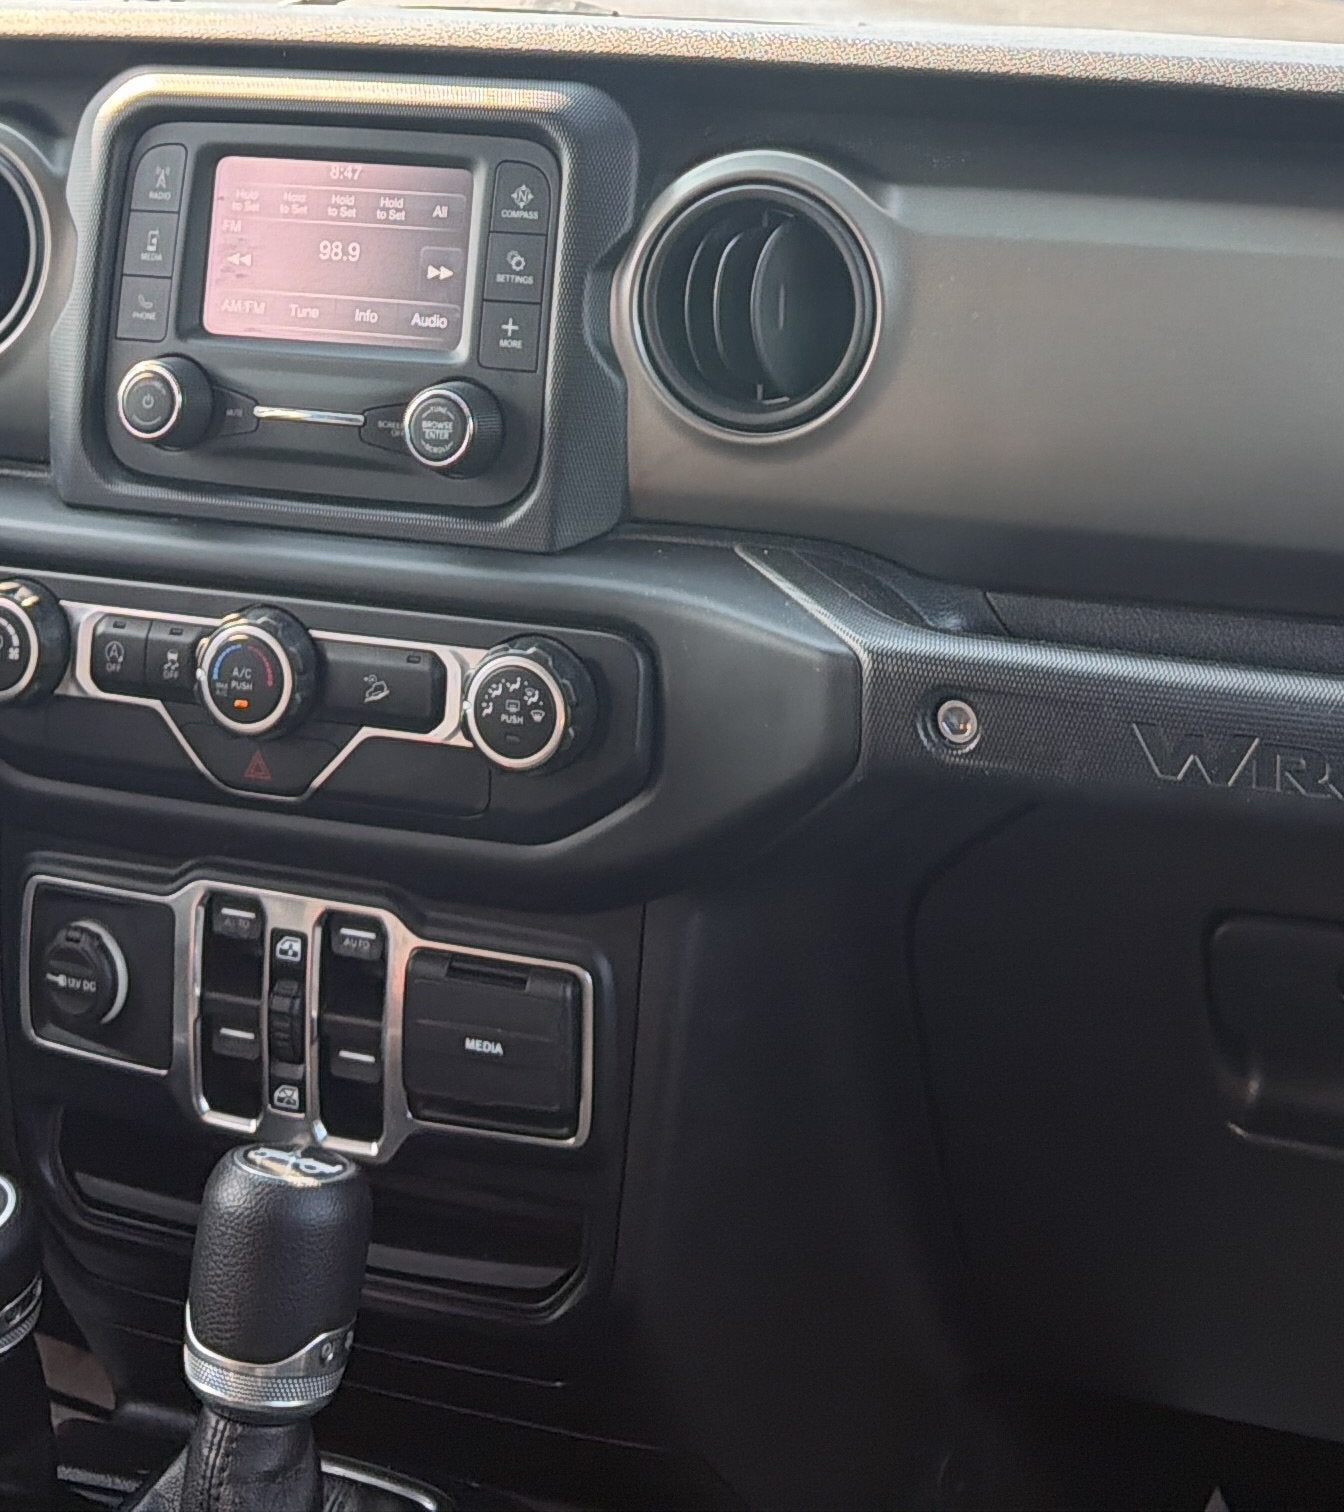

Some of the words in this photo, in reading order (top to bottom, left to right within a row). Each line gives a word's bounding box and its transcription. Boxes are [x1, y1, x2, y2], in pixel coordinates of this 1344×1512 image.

[329, 165, 363, 180] 8:47
[148, 190, 172, 201] RADIO
[331, 194, 355, 206] Hold
[380, 196, 404, 209] Hold
[292, 203, 308, 216] Set
[327, 206, 339, 217] to
[340, 206, 357, 219] Set
[376, 208, 388, 220] to
[388, 209, 406, 222] Set
[432, 205, 449, 218] All
[501, 208, 539, 220] COMPASS
[222, 219, 242, 232] FM
[318, 239, 361, 263] 98.9
[495, 273, 534, 285] SETTINGS
[289, 303, 320, 319] Tune
[355, 308, 379, 324] Info
[411, 312, 448, 329] Audio
[499, 338, 523, 349] MORE
[421, 420, 454, 429] BROWSE
[106, 663, 122, 673] OFF
[232, 666, 253, 679] A/C
[162, 670, 180, 680] OFF
[230, 679, 254, 691] PUSH
[500, 713, 524, 725] PUSH
[342, 937, 371, 950] AUTO
[82, 979, 97, 992] DC
[464, 1037, 504, 1056] MEDIA
